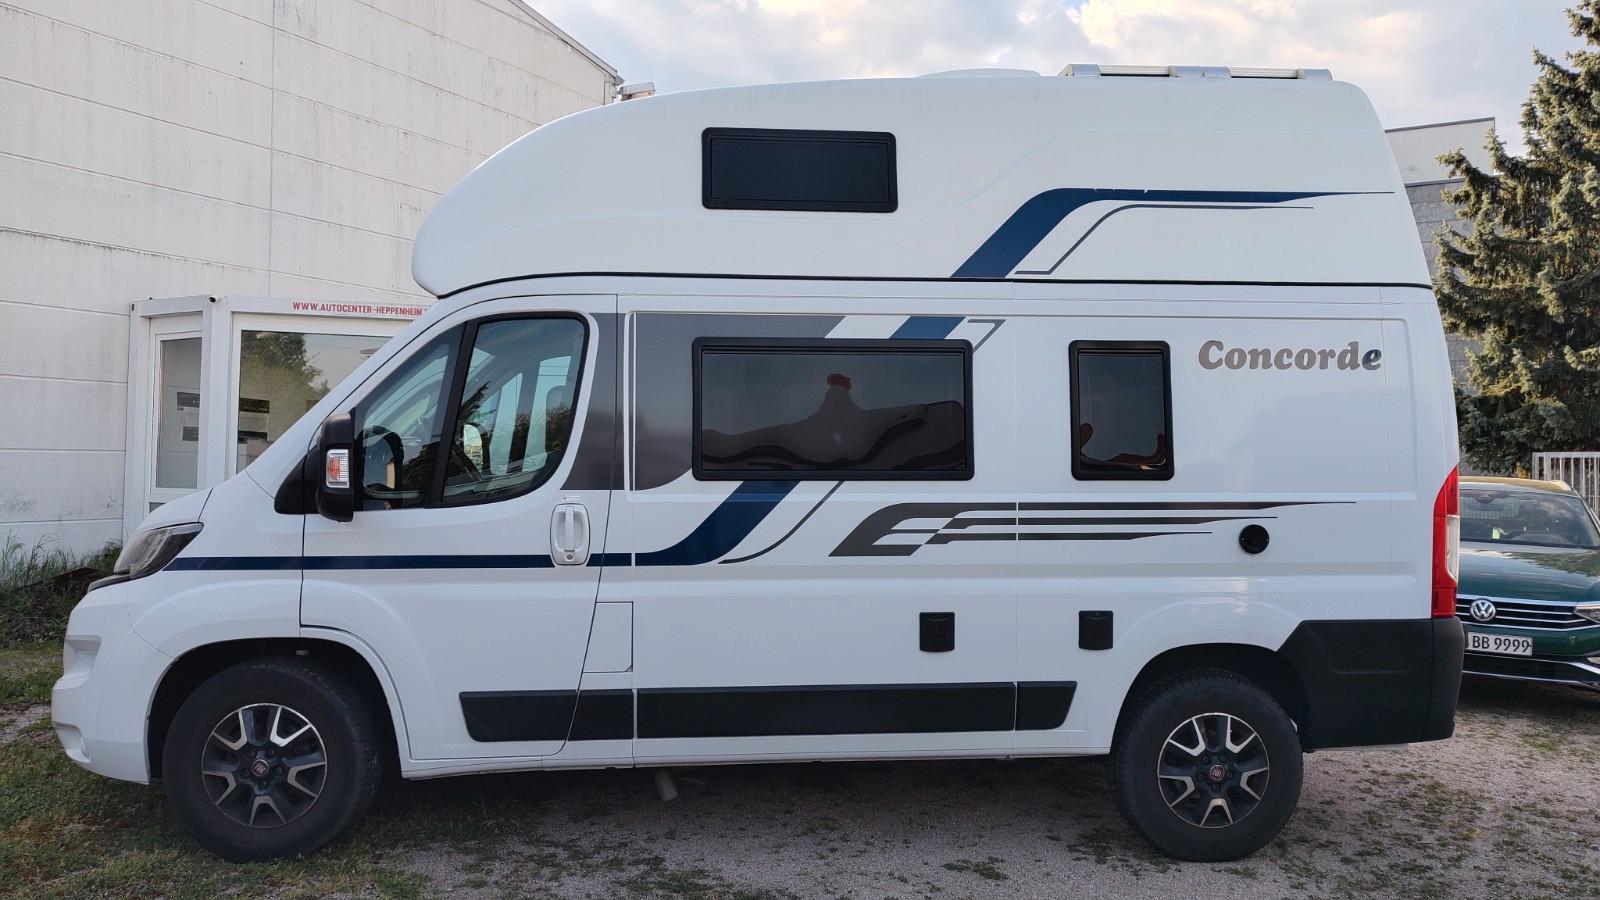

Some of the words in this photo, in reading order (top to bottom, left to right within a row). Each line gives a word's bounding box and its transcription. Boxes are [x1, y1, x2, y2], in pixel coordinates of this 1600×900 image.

[292, 302, 427, 316] WWW.AUTOCENTER-HEPPENHEIM
[1198, 340, 1382, 370] Concorde
[1472, 635, 1490, 649] BB
[1494, 637, 1530, 653] 9999
